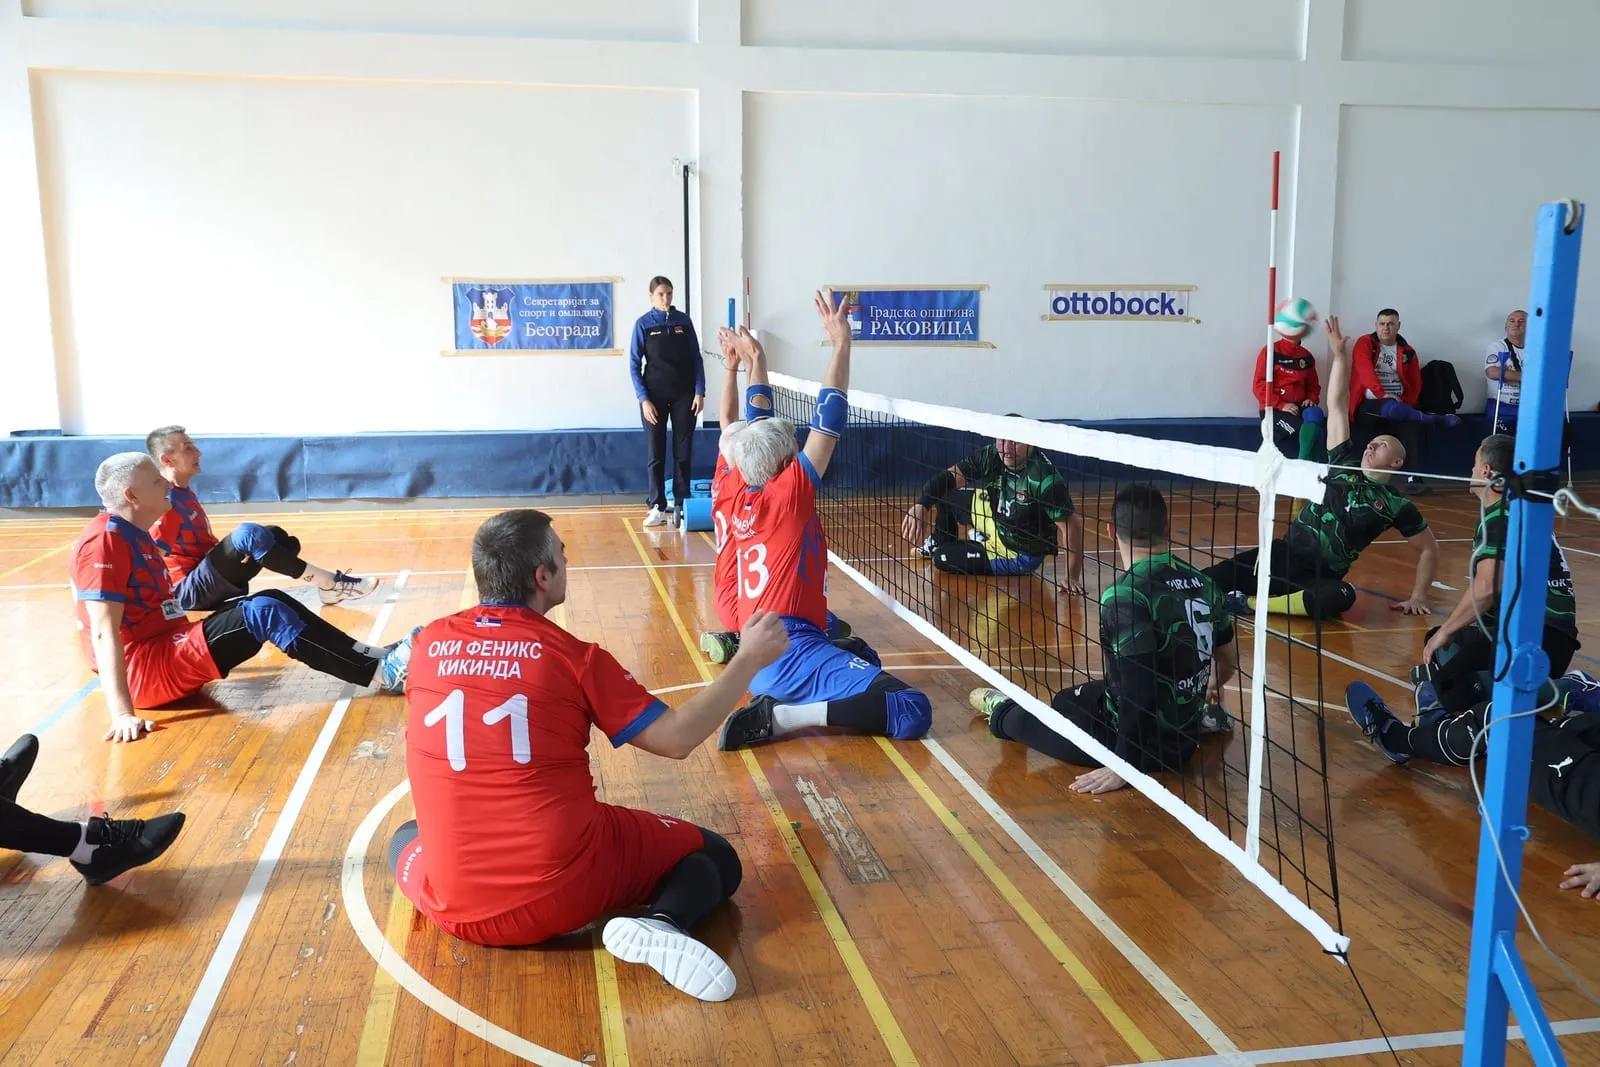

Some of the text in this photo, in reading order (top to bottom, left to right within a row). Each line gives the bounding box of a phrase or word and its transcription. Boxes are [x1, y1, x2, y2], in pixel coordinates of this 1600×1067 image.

[523, 296, 587, 308] Секретаријат
[1052, 292, 1184, 316] ottobock.
[519, 309, 605, 319] спорт и омладину
[870, 306, 975, 320] Градска општина
[525, 321, 601, 340] Београда
[870, 320, 974, 338] РАКОВИЦА
[736, 543, 770, 600] 13
[428, 639, 542, 659] ОКИ ФЕНИКС
[437, 659, 522, 680] КИКИНДА
[423, 688, 532, 772] 11
